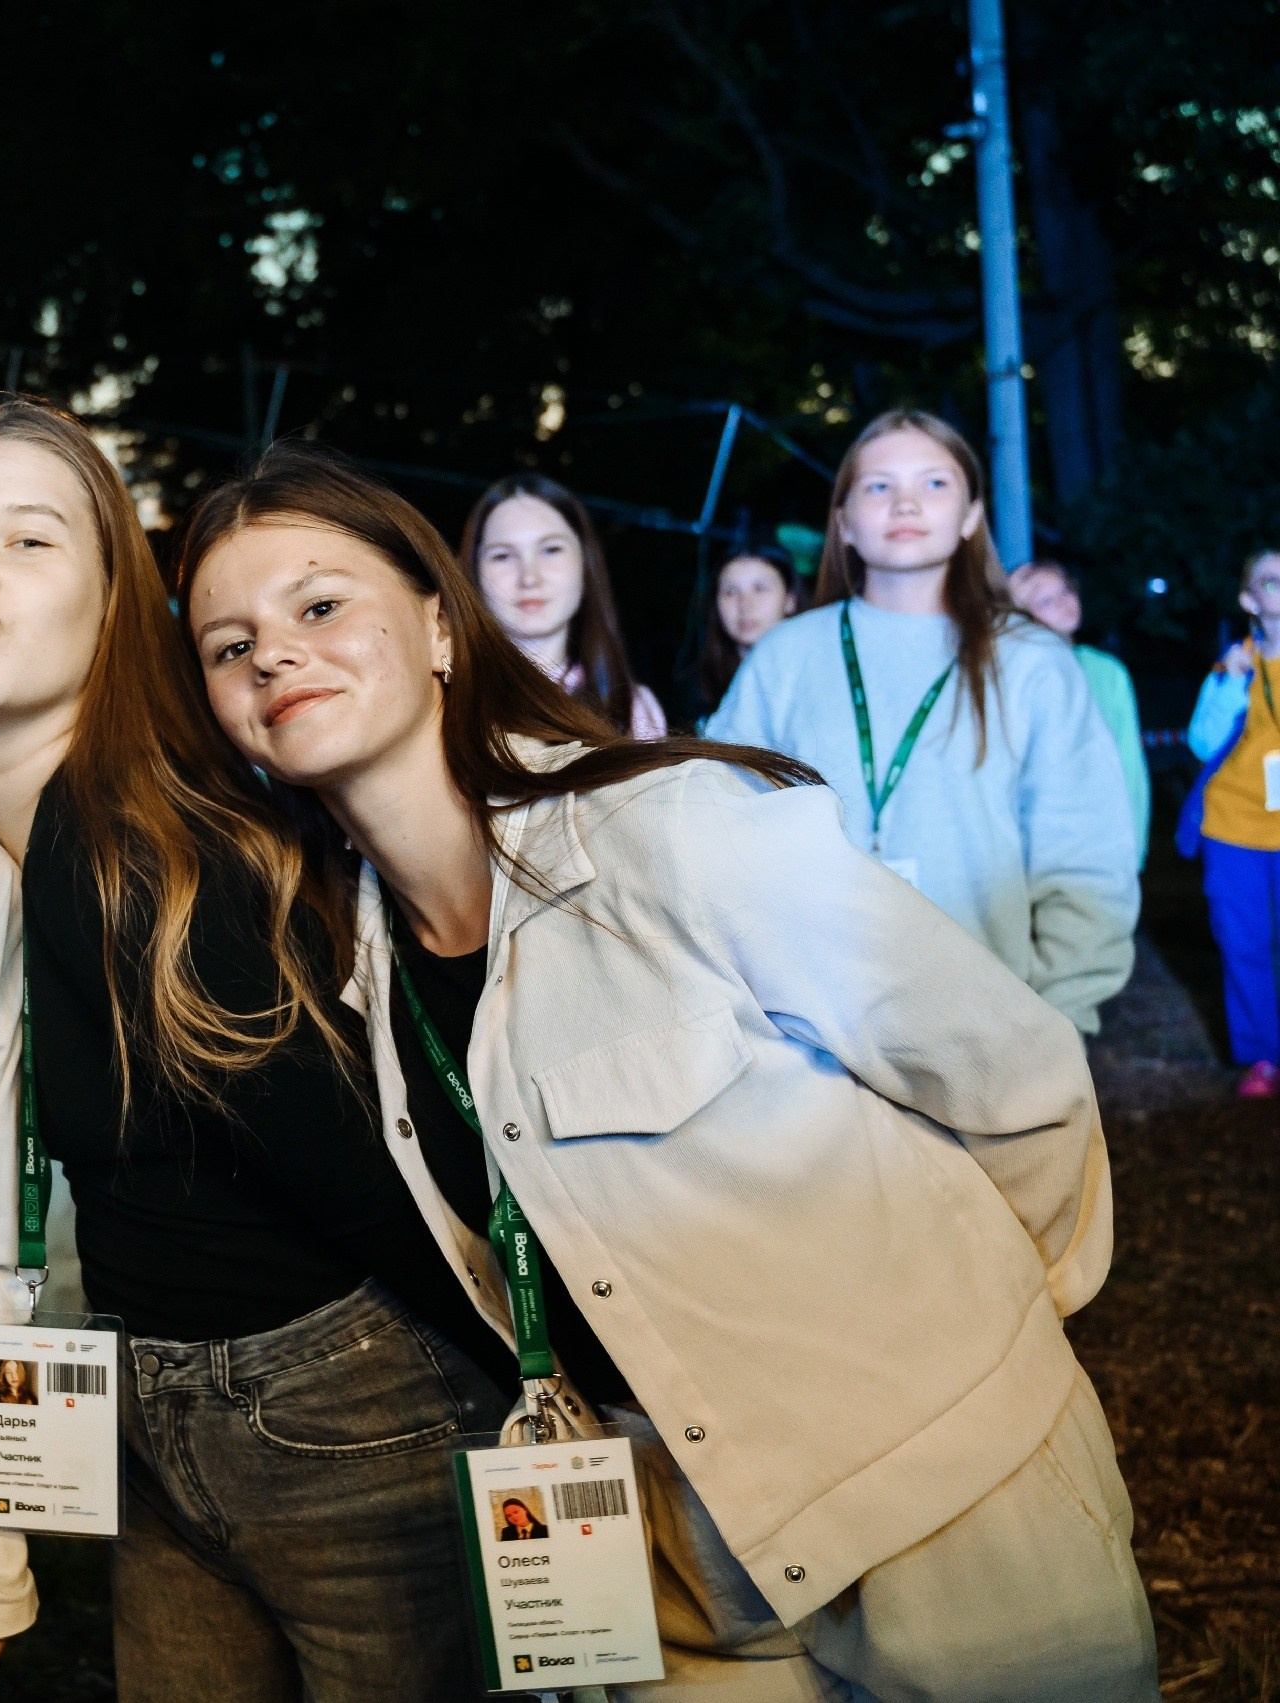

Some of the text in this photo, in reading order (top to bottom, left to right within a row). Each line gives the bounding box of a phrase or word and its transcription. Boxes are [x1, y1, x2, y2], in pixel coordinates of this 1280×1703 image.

[497, 1554, 551, 1569] Олеся
[500, 1575, 551, 1589] Шуваева
[504, 1597, 564, 1611] Участник
